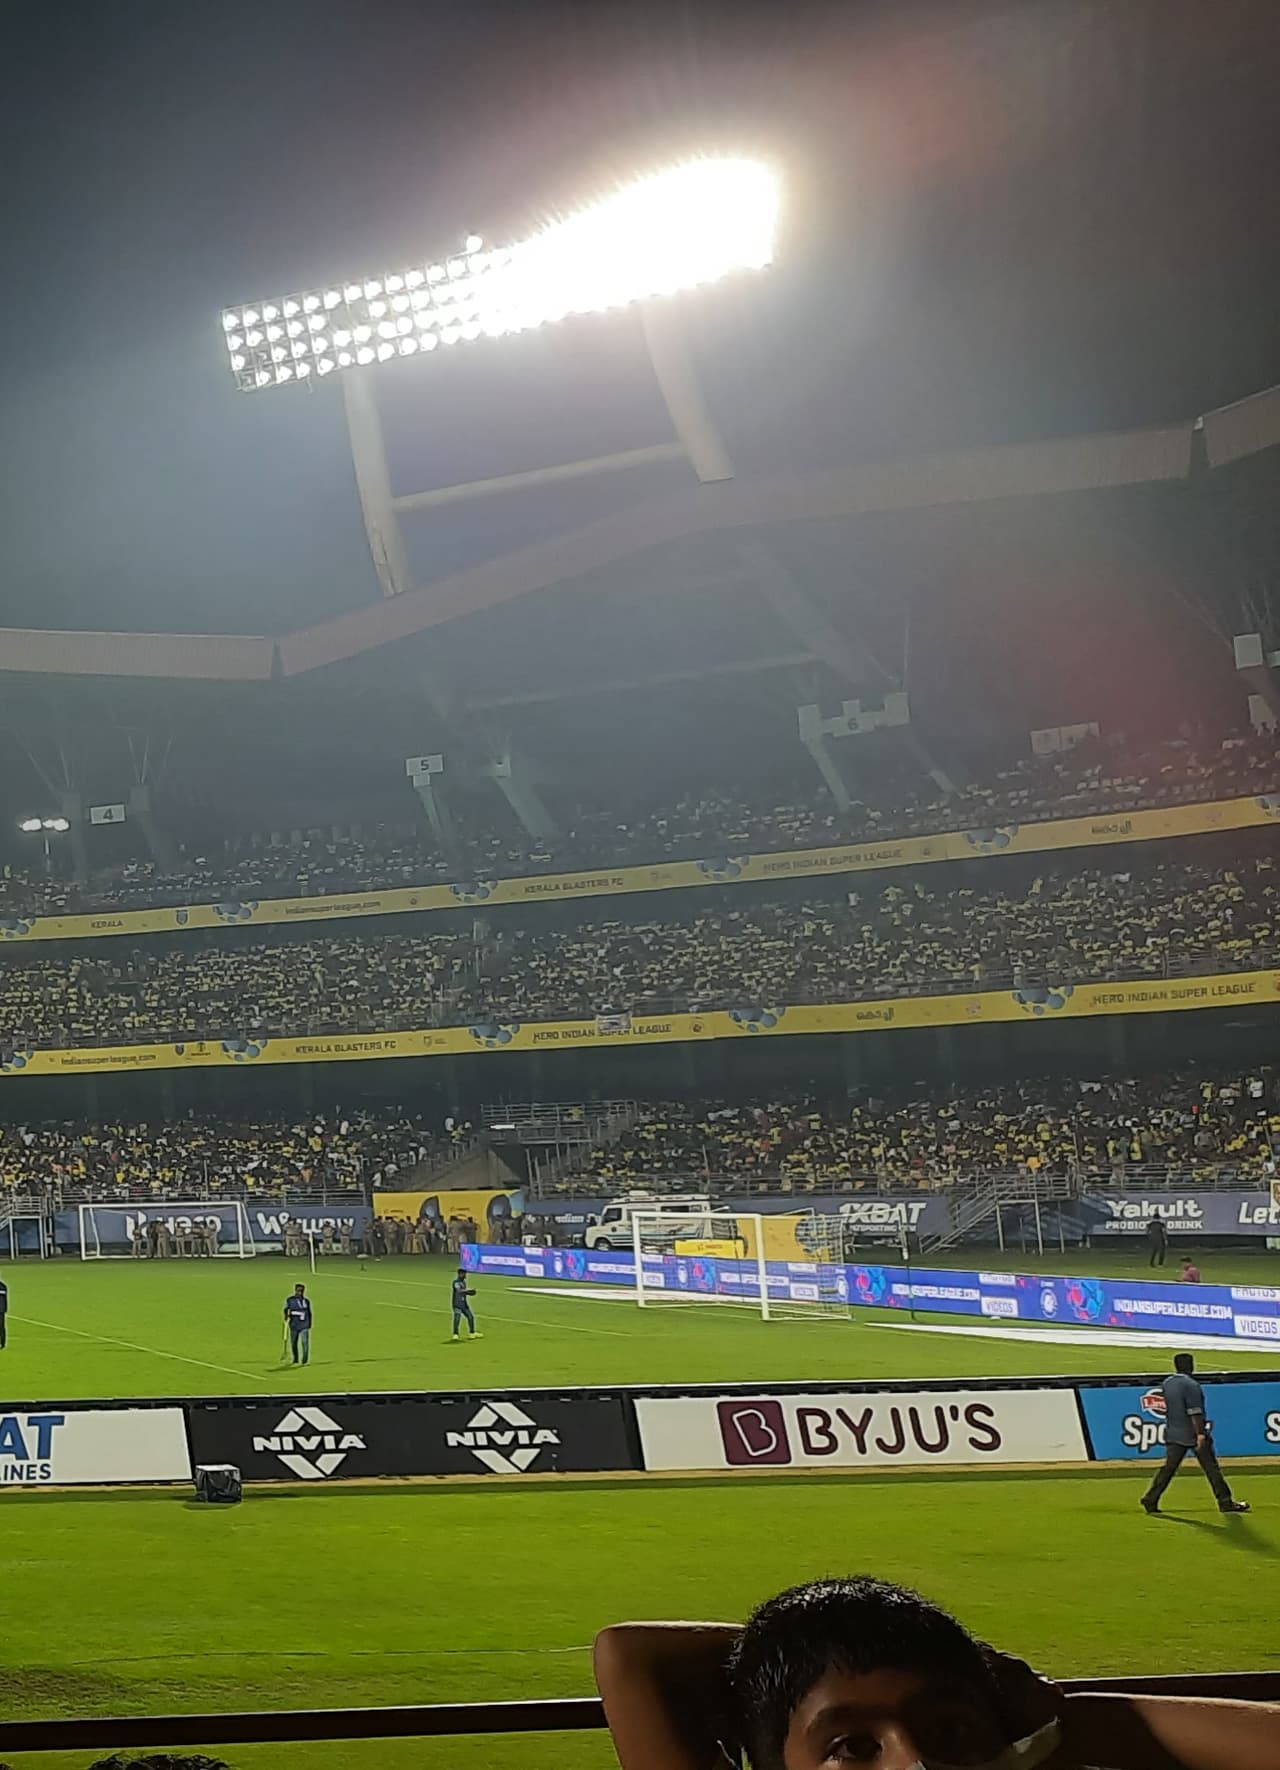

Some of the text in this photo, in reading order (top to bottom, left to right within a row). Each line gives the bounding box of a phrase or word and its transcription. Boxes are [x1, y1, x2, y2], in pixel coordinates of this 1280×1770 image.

[847, 718, 858, 731] 6
[420, 759, 429, 771] 5
[103, 808, 113, 820] 4
[764, 849, 902, 872] HERO INDIAN SUPER LEAGUE
[524, 877, 624, 893] KERALA BLASTERS FC
[91, 920, 123, 929] KERALA
[1092, 982, 1256, 1005] HERO INDIAN SUPER LEAGUE
[533, 1031, 559, 1043] HERO
[562, 1029, 596, 1039] INDIAN
[633, 1024, 672, 1035] LEAGUE
[296, 1040, 396, 1054] KERALA BLASTERS FC
[840, 1202, 927, 1224] 1XBAT
[1105, 1200, 1203, 1218] Yakult
[1105, 1220, 1203, 1230] PROBIO DRINK
[1113, 1298, 1233, 1320] INDIANSUPERLEAGUE.COM
[1240, 1319, 1278, 1334] VIDEOS
[445, 1428, 560, 1447] NIVIA
[797, 1402, 1002, 1455] BYJU'S
[253, 1433, 366, 1452] NIVIA
